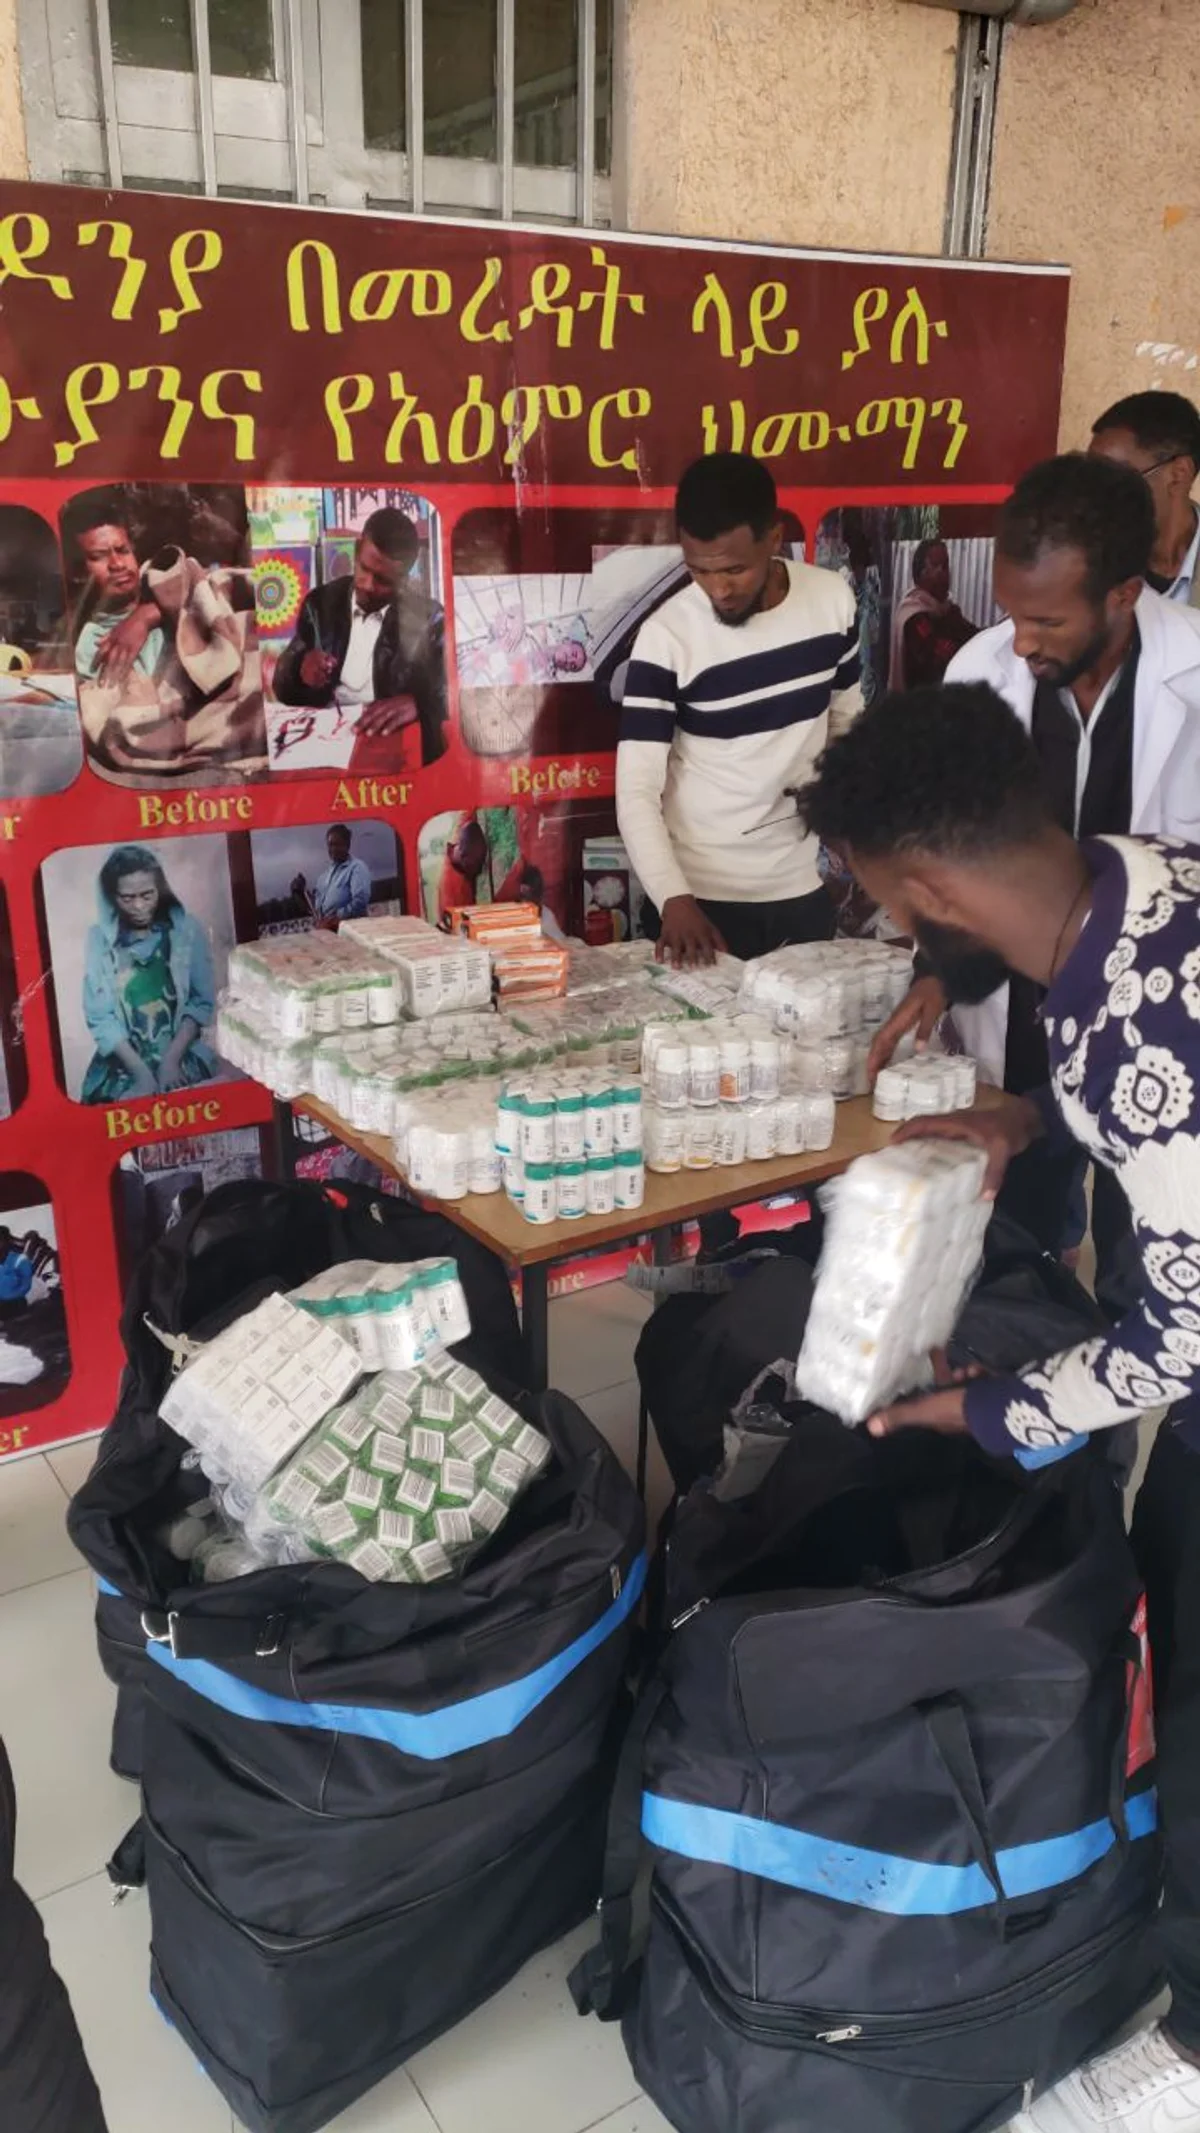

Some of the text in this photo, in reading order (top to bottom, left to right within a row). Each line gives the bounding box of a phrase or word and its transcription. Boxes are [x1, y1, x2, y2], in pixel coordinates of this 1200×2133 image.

[285, 239, 647, 356] በመረዳት
[692, 272, 801, 369] ላይ
[840, 286, 951, 371] ያሉ
[510, 760, 600, 795] Before
[139, 778, 413, 829] Before After
[106, 1097, 221, 1140] Before
